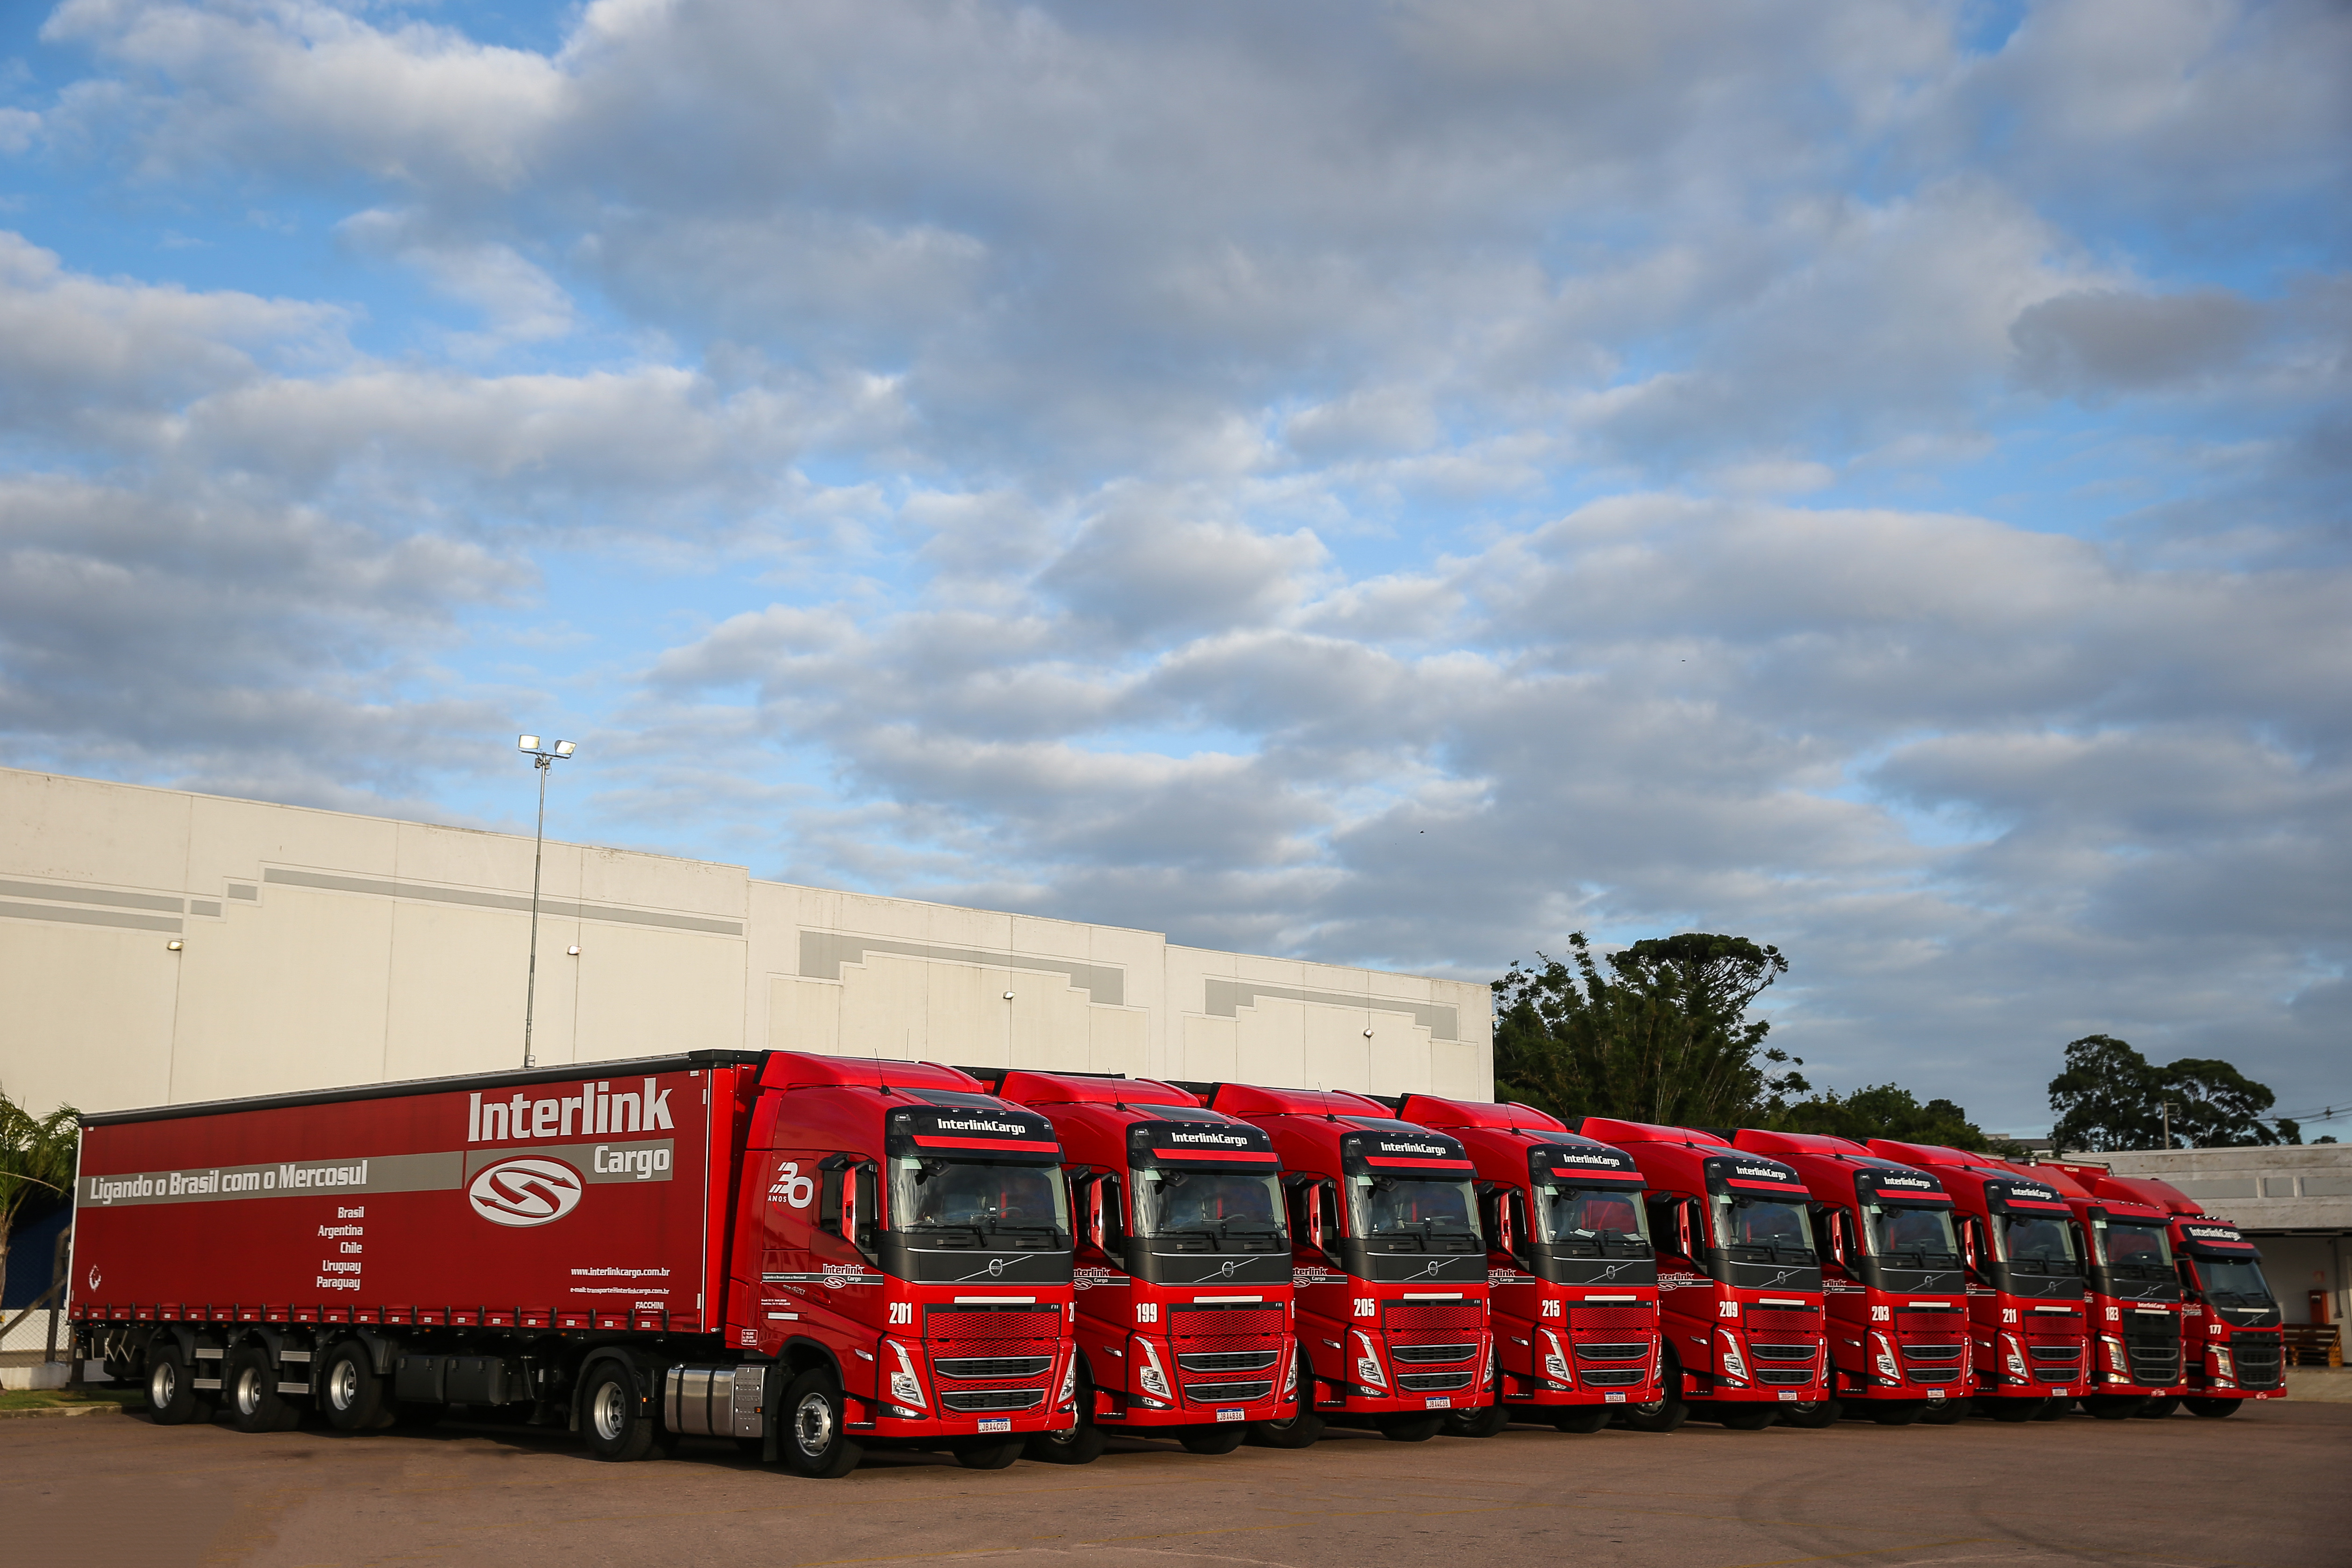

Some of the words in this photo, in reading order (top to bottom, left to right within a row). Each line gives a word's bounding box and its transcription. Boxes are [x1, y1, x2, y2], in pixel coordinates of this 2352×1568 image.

[467, 1077, 675, 1142] Interlink
[937, 1118, 1026, 1135] InterlinkCargo
[1171, 1132, 1248, 1147] InterlinkCargo
[1380, 1141, 1447, 1156] InterlinkCargo
[594, 1145, 670, 1179] Cargo
[1563, 1154, 1620, 1167] InterlinkCargo
[1736, 1166, 1787, 1180] InterlinkCargo
[90, 1175, 153, 1205] Ligando
[155, 1179, 166, 1196] o
[169, 1169, 220, 1195] Brasil
[222, 1173, 260, 1191] com
[263, 1171, 276, 1189] o
[278, 1160, 368, 1189] Mercosul
[769, 1162, 813, 1208] 30
[337, 1206, 364, 1218] Brasil
[317, 1224, 363, 1239] Argentina
[340, 1242, 363, 1254] Chile
[322, 1260, 361, 1274] Uruguay
[570, 1267, 670, 1278] www.interlinkcargo.com.br
[823, 1263, 865, 1275] Interlink
[1073, 1267, 1111, 1277] nterlink
[316, 1276, 361, 1291] Paraguay
[1657, 1272, 1695, 1281] nterlink
[791, 1286, 805, 1295] 420
[889, 1302, 912, 1324] 201
[1136, 1303, 1157, 1323] 199
[1354, 1298, 1375, 1317] 205
[1542, 1300, 1560, 1317] 215
[1719, 1301, 1738, 1318] 209
[1871, 1305, 1889, 1321] 203
[2003, 1308, 2017, 1323] 211
[2209, 1325, 2222, 1334] 177
